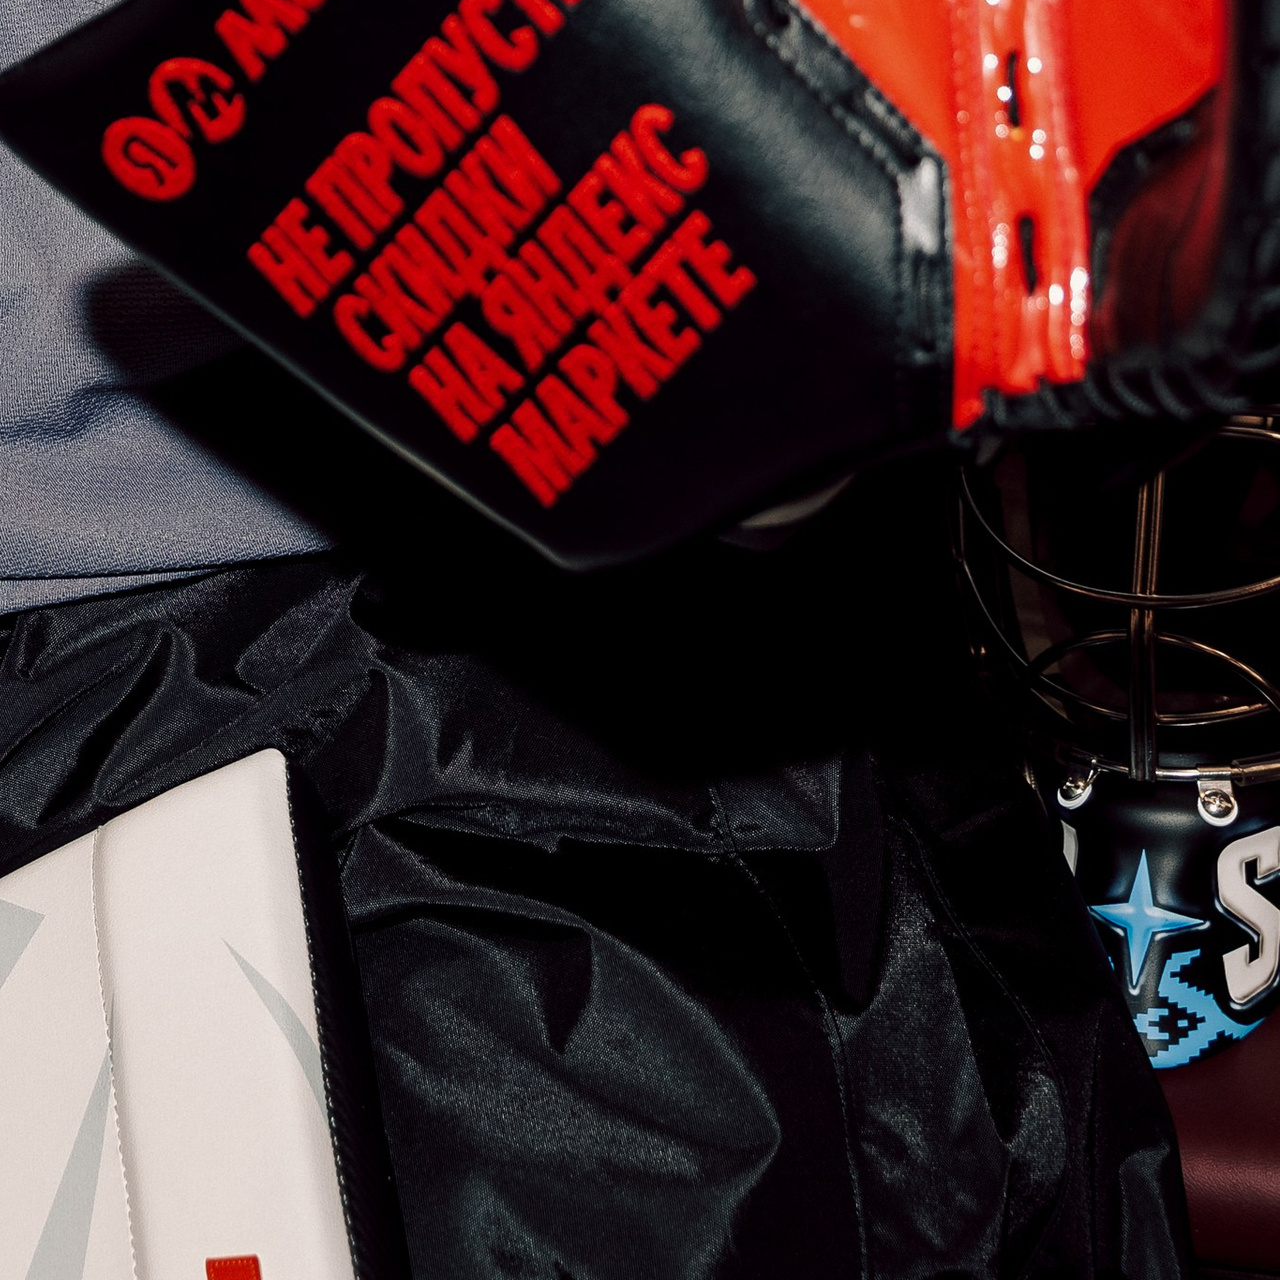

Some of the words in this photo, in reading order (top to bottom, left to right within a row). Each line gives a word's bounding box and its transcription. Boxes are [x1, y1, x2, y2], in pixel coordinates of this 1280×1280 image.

[247, 198, 354, 317] НЕ
[333, 113, 561, 374] СКИДКИ
[408, 321, 526, 443] НА
[480, 102, 710, 374] ЯНДЕКС
[489, 210, 756, 508] МАРКЕТЕ
